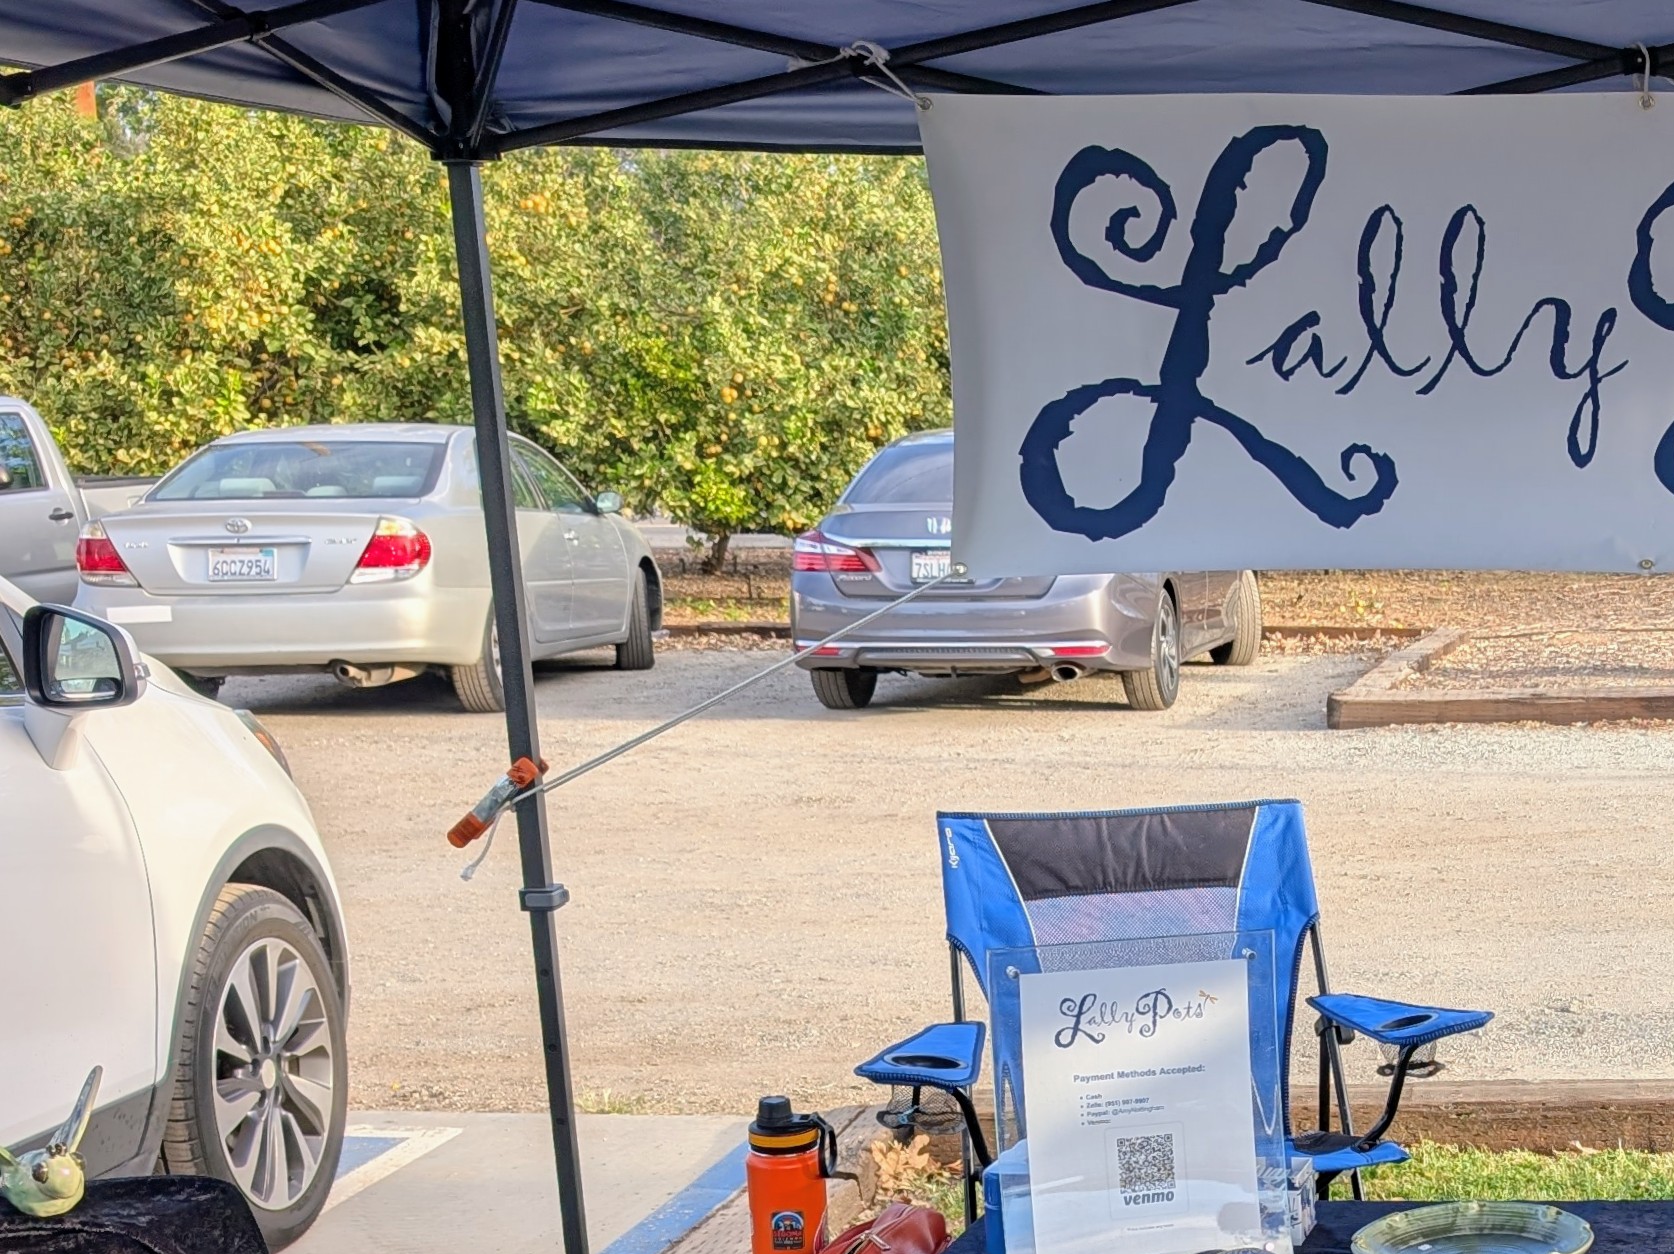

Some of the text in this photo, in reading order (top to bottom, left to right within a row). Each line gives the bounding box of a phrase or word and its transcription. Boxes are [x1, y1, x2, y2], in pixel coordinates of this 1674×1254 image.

[212, 559, 272, 577] 6CCZ954
[914, 562, 952, 579] 7SLH
[1073, 1064, 1206, 1084] Payment Methods Accepted:
[1123, 1190, 1175, 1206] venmo
